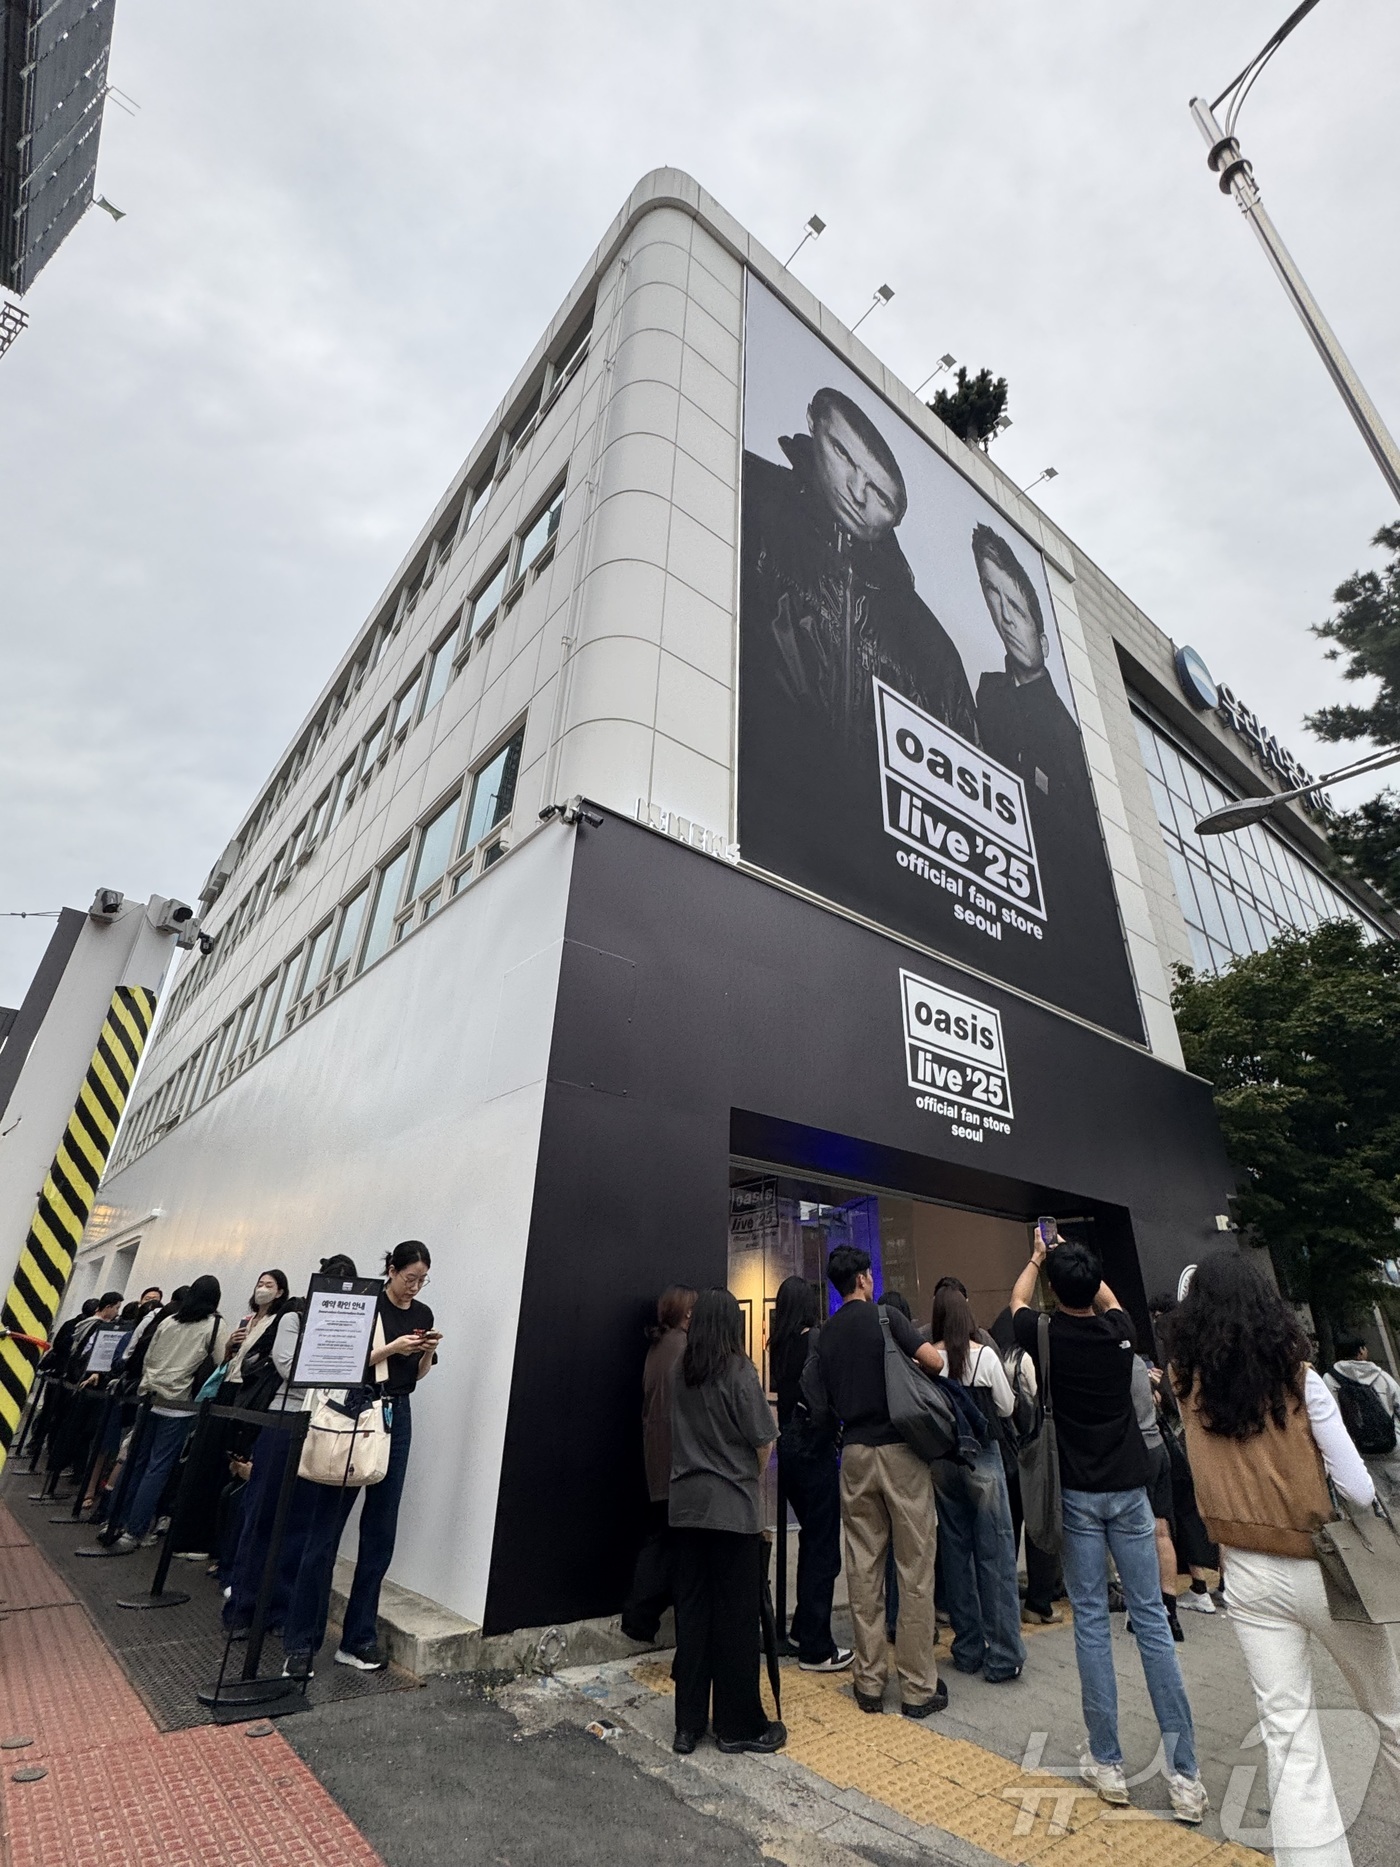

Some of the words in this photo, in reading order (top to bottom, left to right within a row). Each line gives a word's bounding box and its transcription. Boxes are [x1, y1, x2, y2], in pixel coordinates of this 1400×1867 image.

[895, 727, 1017, 825] oasis
[899, 789, 970, 863] live
[896, 850, 963, 898] official
[968, 885, 997, 916] fan
[1001, 906, 1043, 940] store
[953, 903, 1002, 941] seoul
[914, 1001, 995, 1051] oasis
[917, 1050, 963, 1092] live
[915, 1095, 958, 1119] official
[960, 1107, 980, 1125] fan
[982, 1116, 1011, 1135] store
[951, 1124, 983, 1143] seoul
[321, 1300, 337, 1309] 예약
[337, 1300, 352, 1310] 확인
[352, 1301, 366, 1311] 안내
